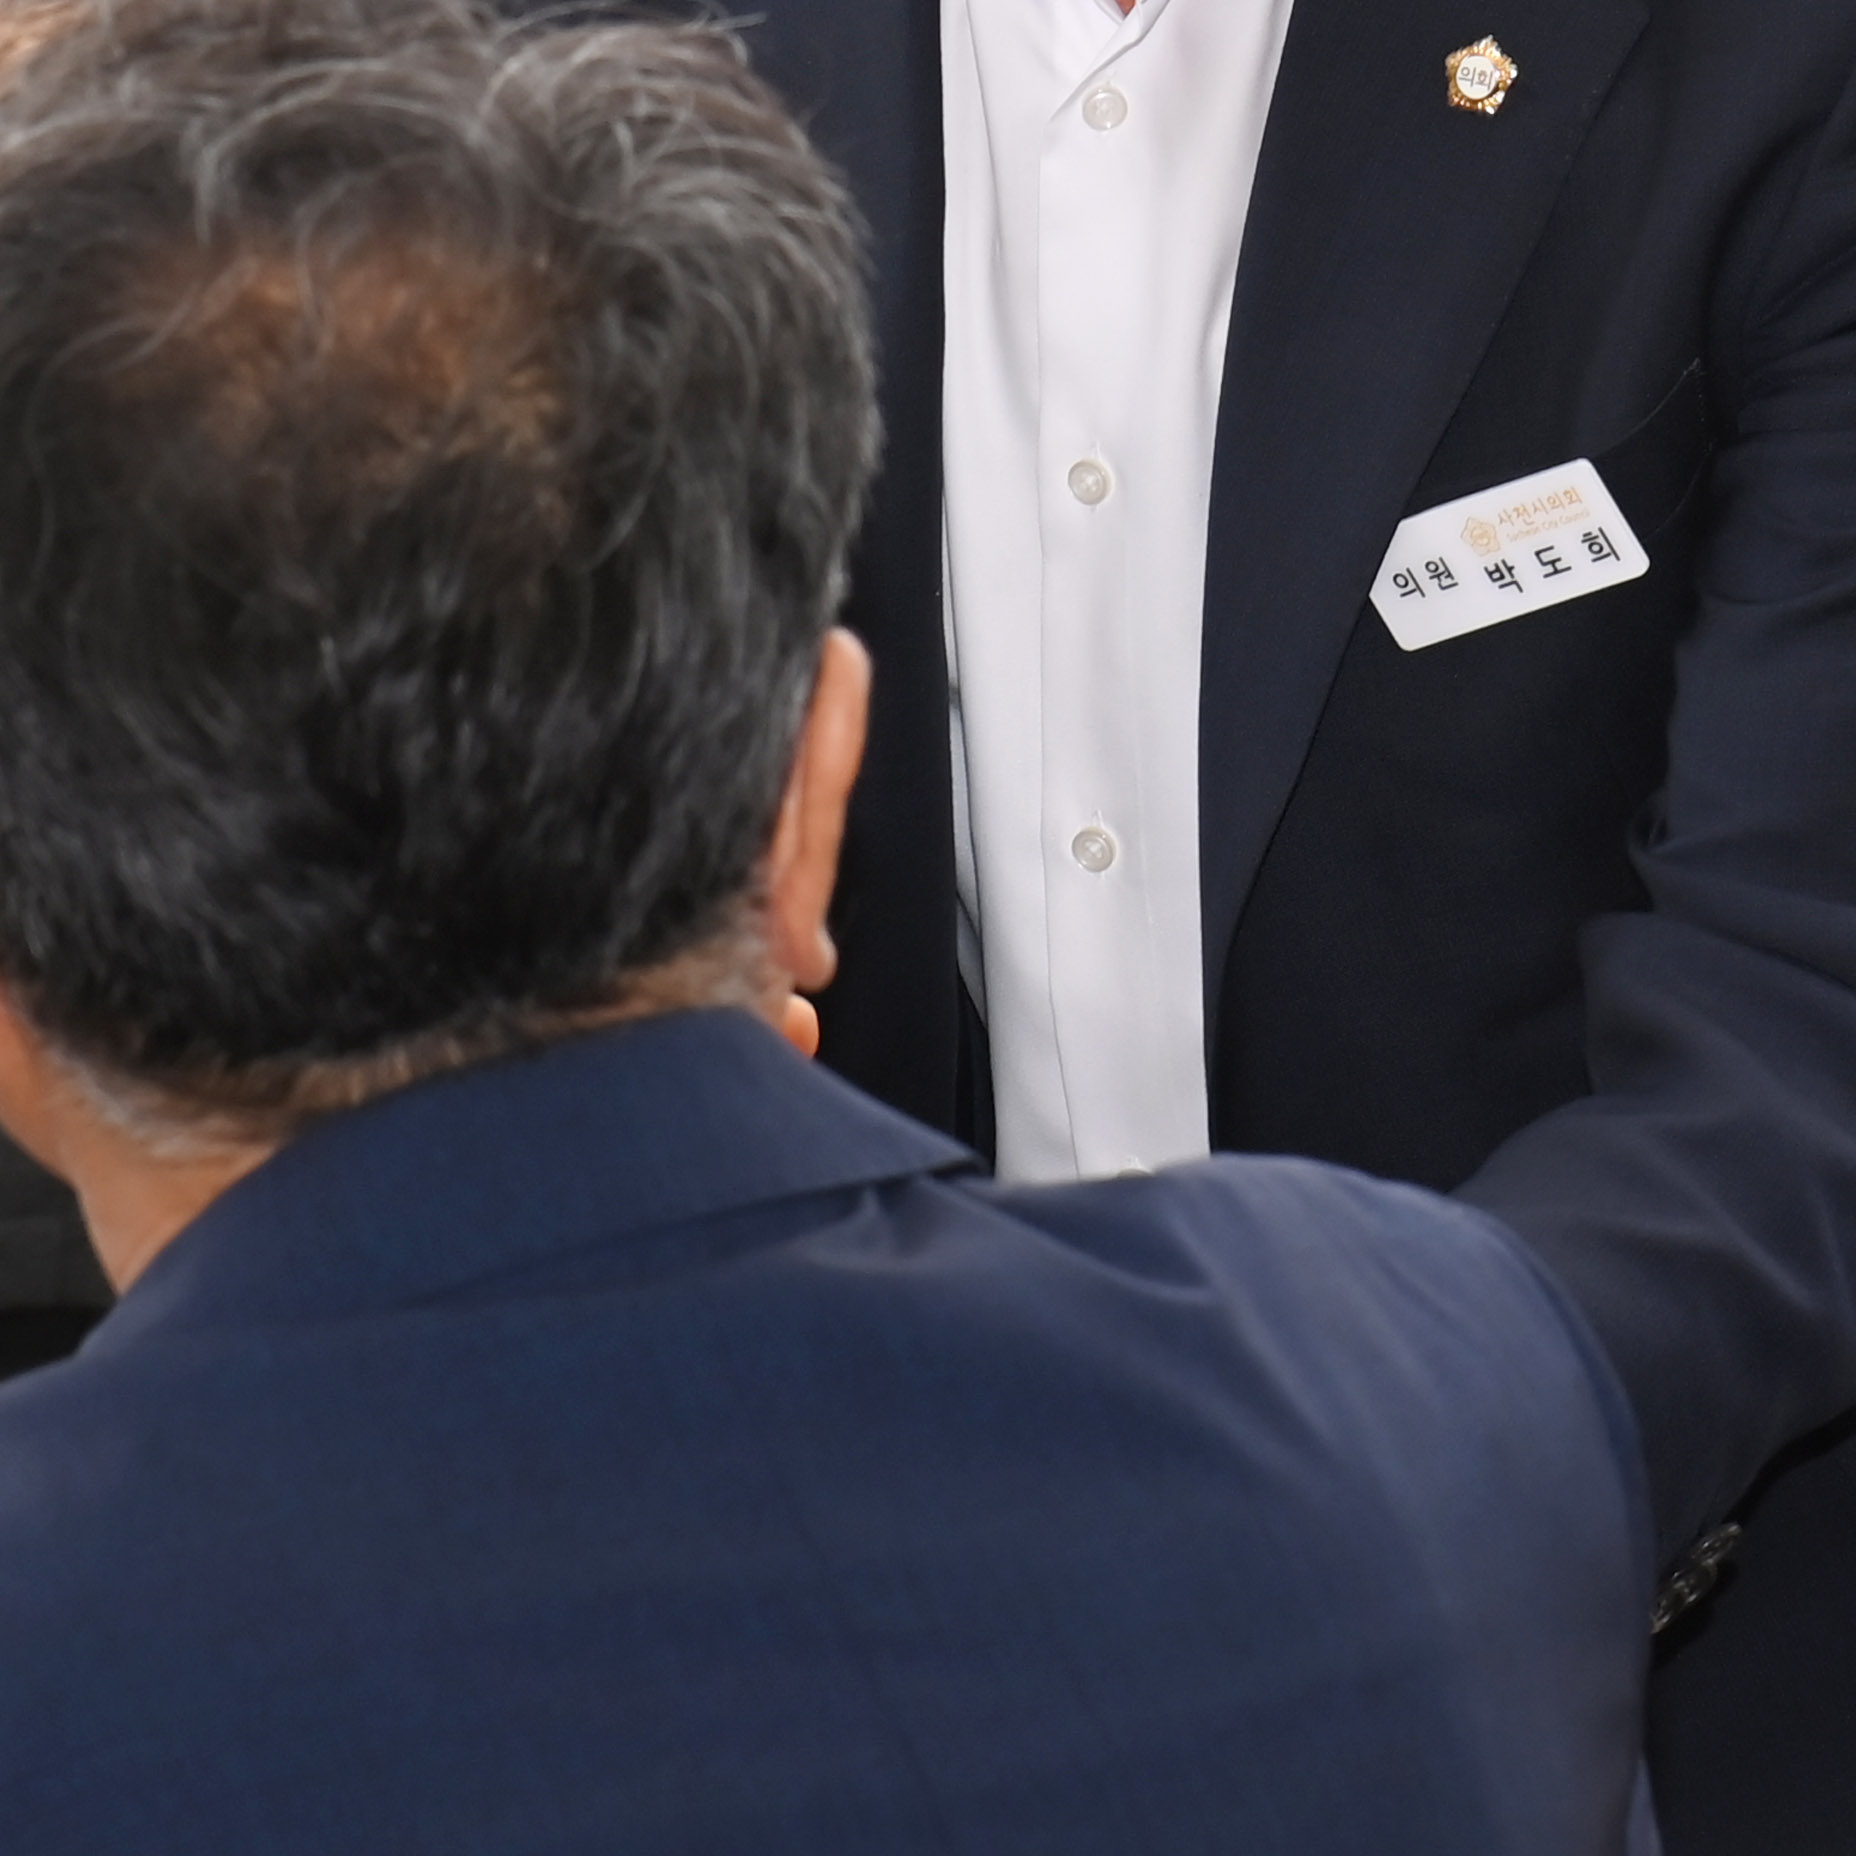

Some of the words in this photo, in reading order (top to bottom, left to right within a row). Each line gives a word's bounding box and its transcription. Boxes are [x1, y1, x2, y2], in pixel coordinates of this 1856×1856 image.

[1459, 66, 1494, 91] 의회
[1497, 486, 1582, 526] 사천시의회
[1393, 556, 1459, 599] 의원
[1484, 526, 1621, 594] 박도희
